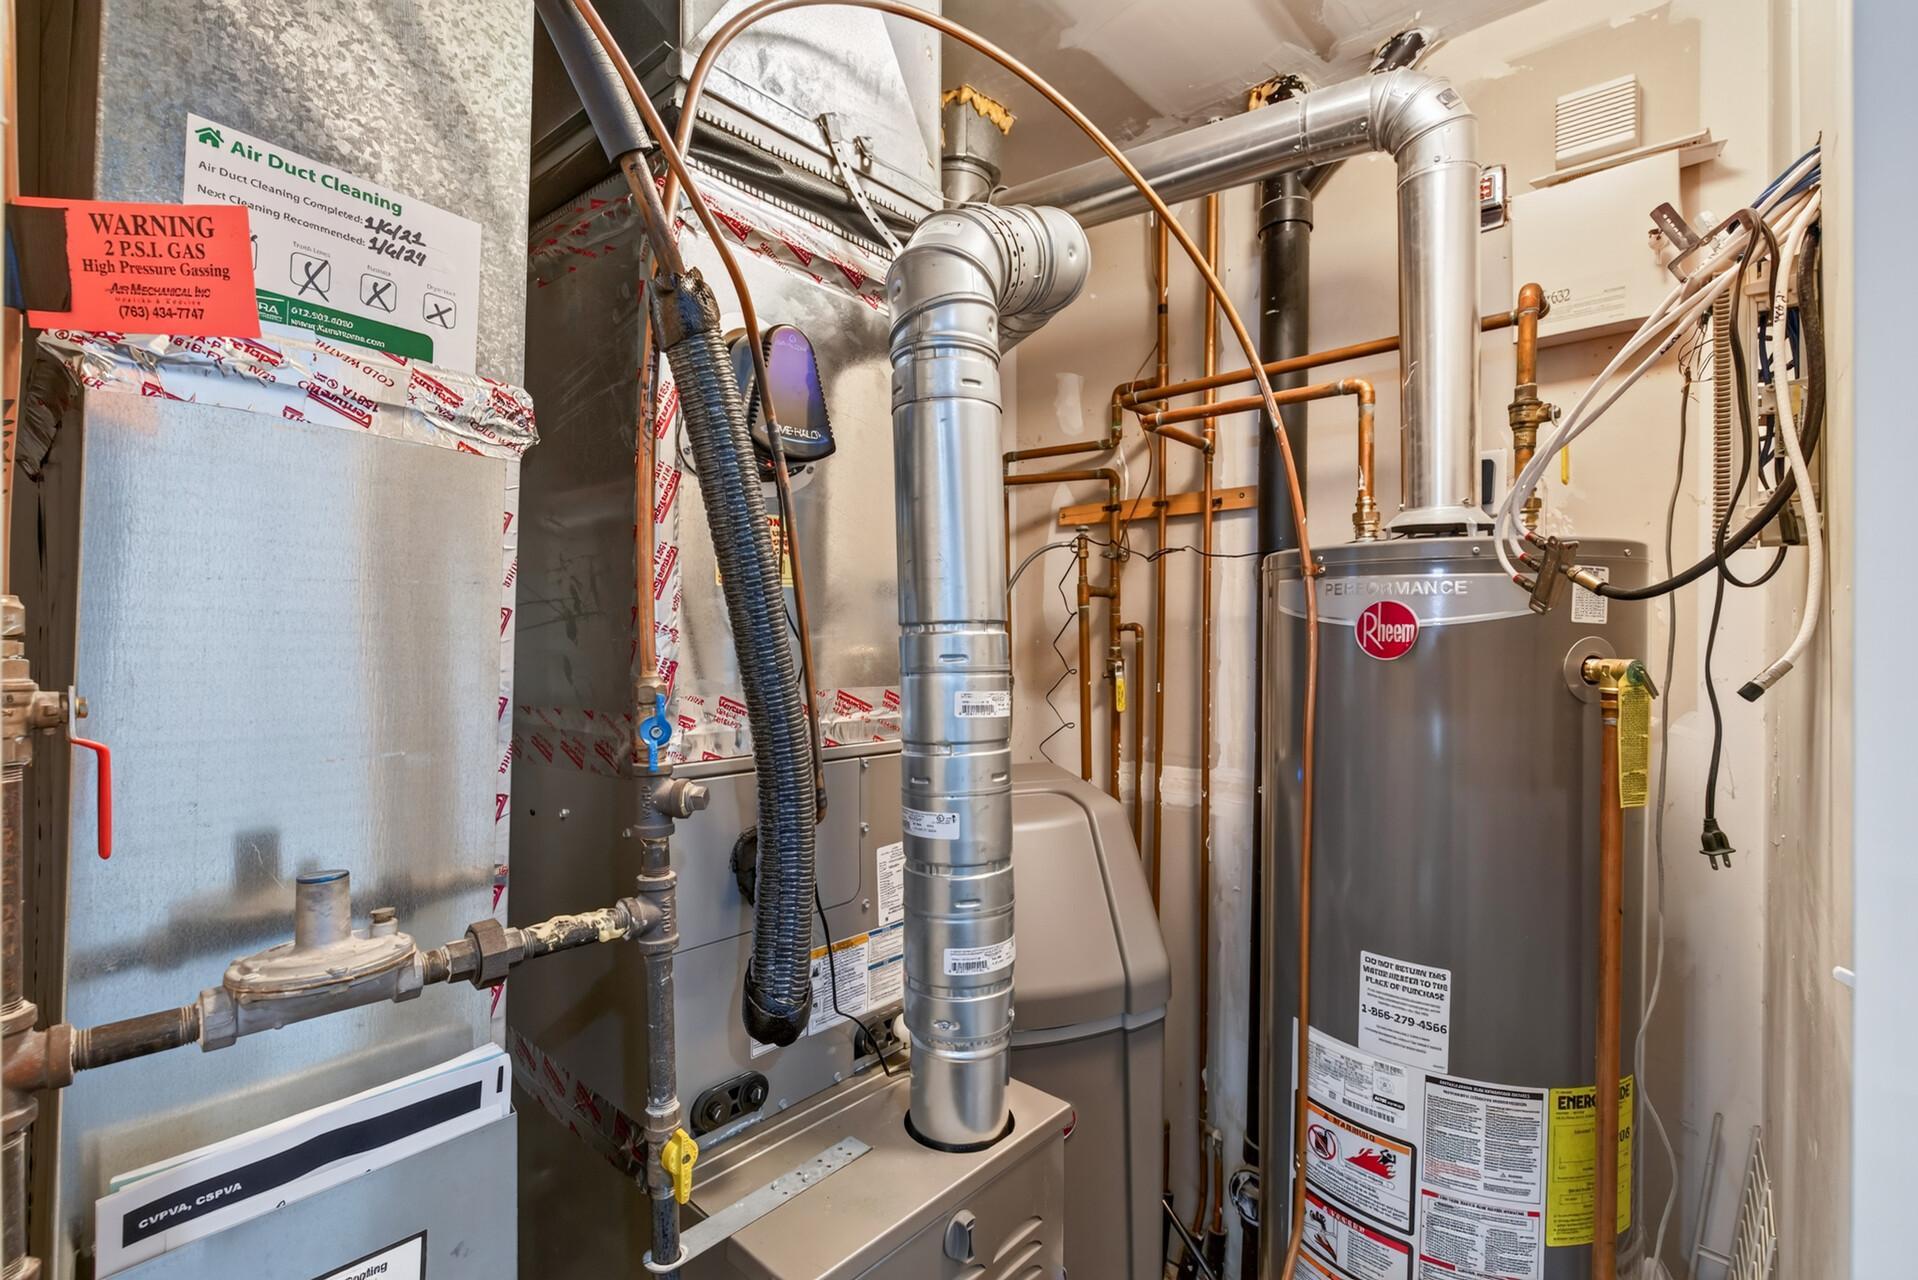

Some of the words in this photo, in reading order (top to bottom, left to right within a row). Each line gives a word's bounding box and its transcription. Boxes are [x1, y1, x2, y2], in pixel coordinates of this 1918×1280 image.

[199, 161, 216, 173] Air
[219, 167, 247, 185] Duct
[251, 179, 300, 204] Cleaning
[303, 196, 363, 224] Completed:
[231, 141, 261, 162] Air
[268, 154, 316, 183] Duct
[321, 174, 402, 216] Cleaning
[88, 213, 214, 238] WARNING
[197, 184, 225, 200] Next
[229, 195, 280, 219] Cleaning
[283, 212, 366, 247] Recommended:
[105, 240, 114, 256] 2
[120, 241, 162, 258] P.S.I.
[168, 243, 206, 259] GAS
[82, 259, 115, 276] High
[120, 261, 176, 277] Pressure
[180, 265, 230, 280] Gassing
[119, 305, 149, 320] (763)
[152, 307, 204, 320] 434-7747
[1325, 580, 1468, 596] PERFORMANCE
[1363, 603, 1415, 650] Rheem
[138, 1203, 192, 1228] CVPVA,
[195, 1182, 242, 1206] CSPVA
